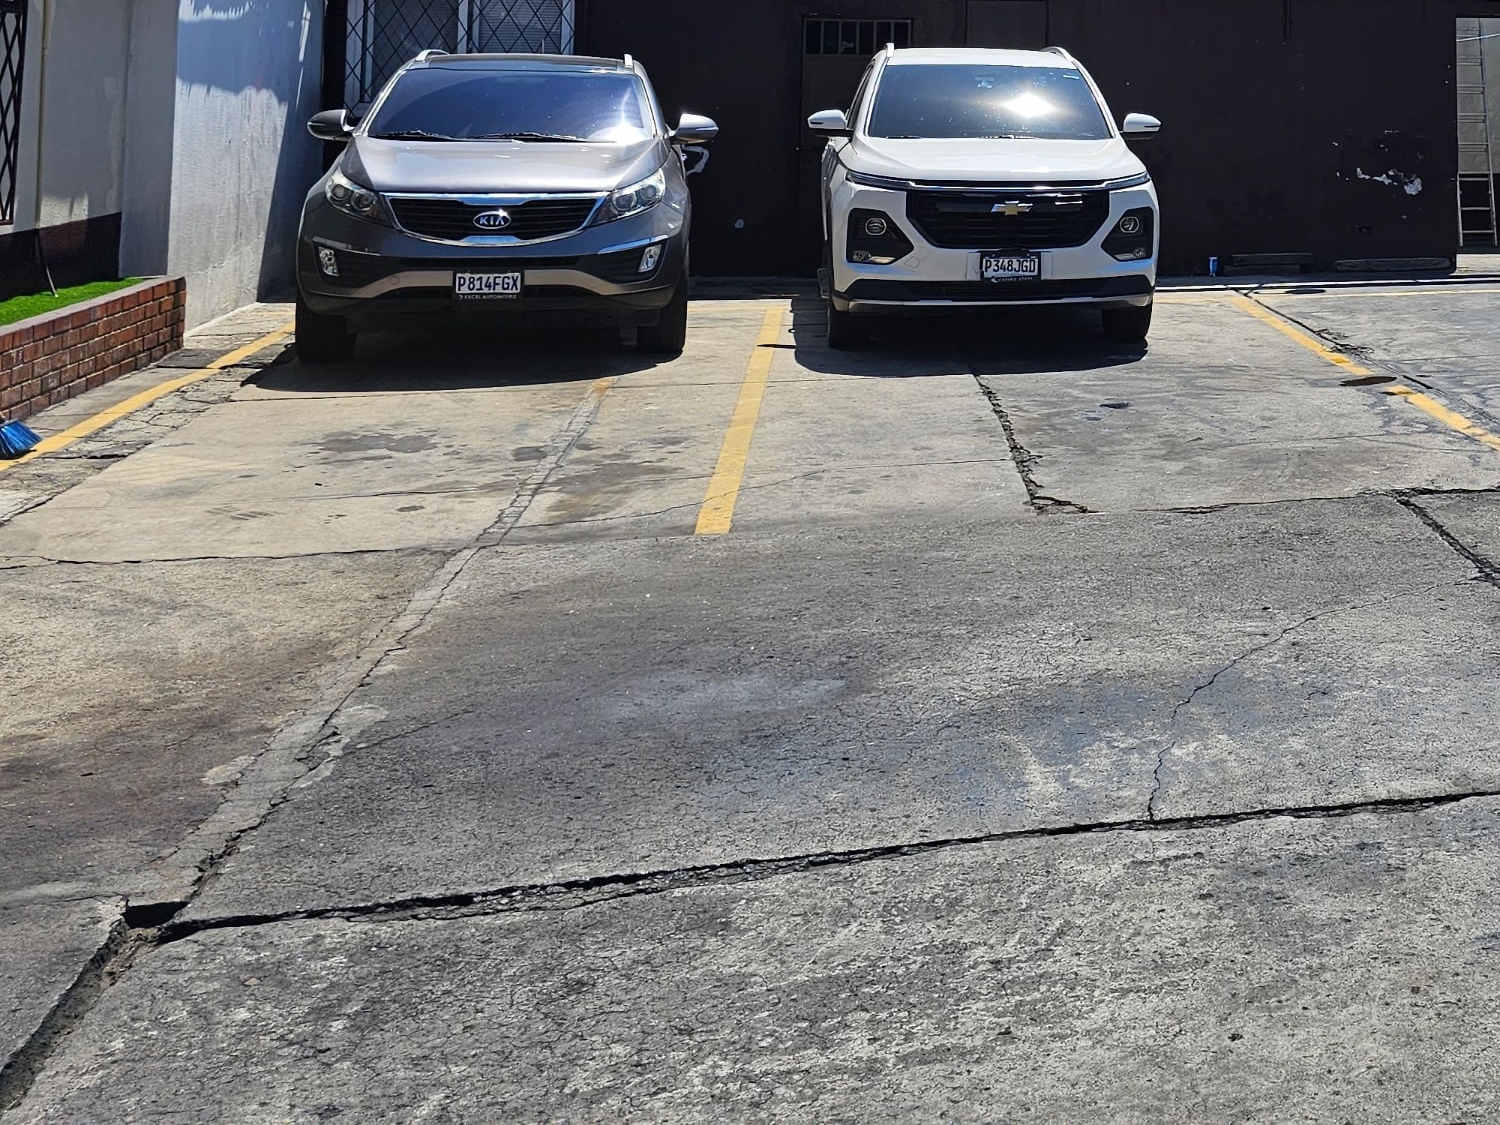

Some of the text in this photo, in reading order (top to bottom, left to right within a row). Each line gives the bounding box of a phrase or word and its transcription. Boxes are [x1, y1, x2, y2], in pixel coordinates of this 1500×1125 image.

[480, 216, 505, 226] KIA
[984, 259, 1036, 273] P348JGD
[457, 275, 519, 291] P814FGX
